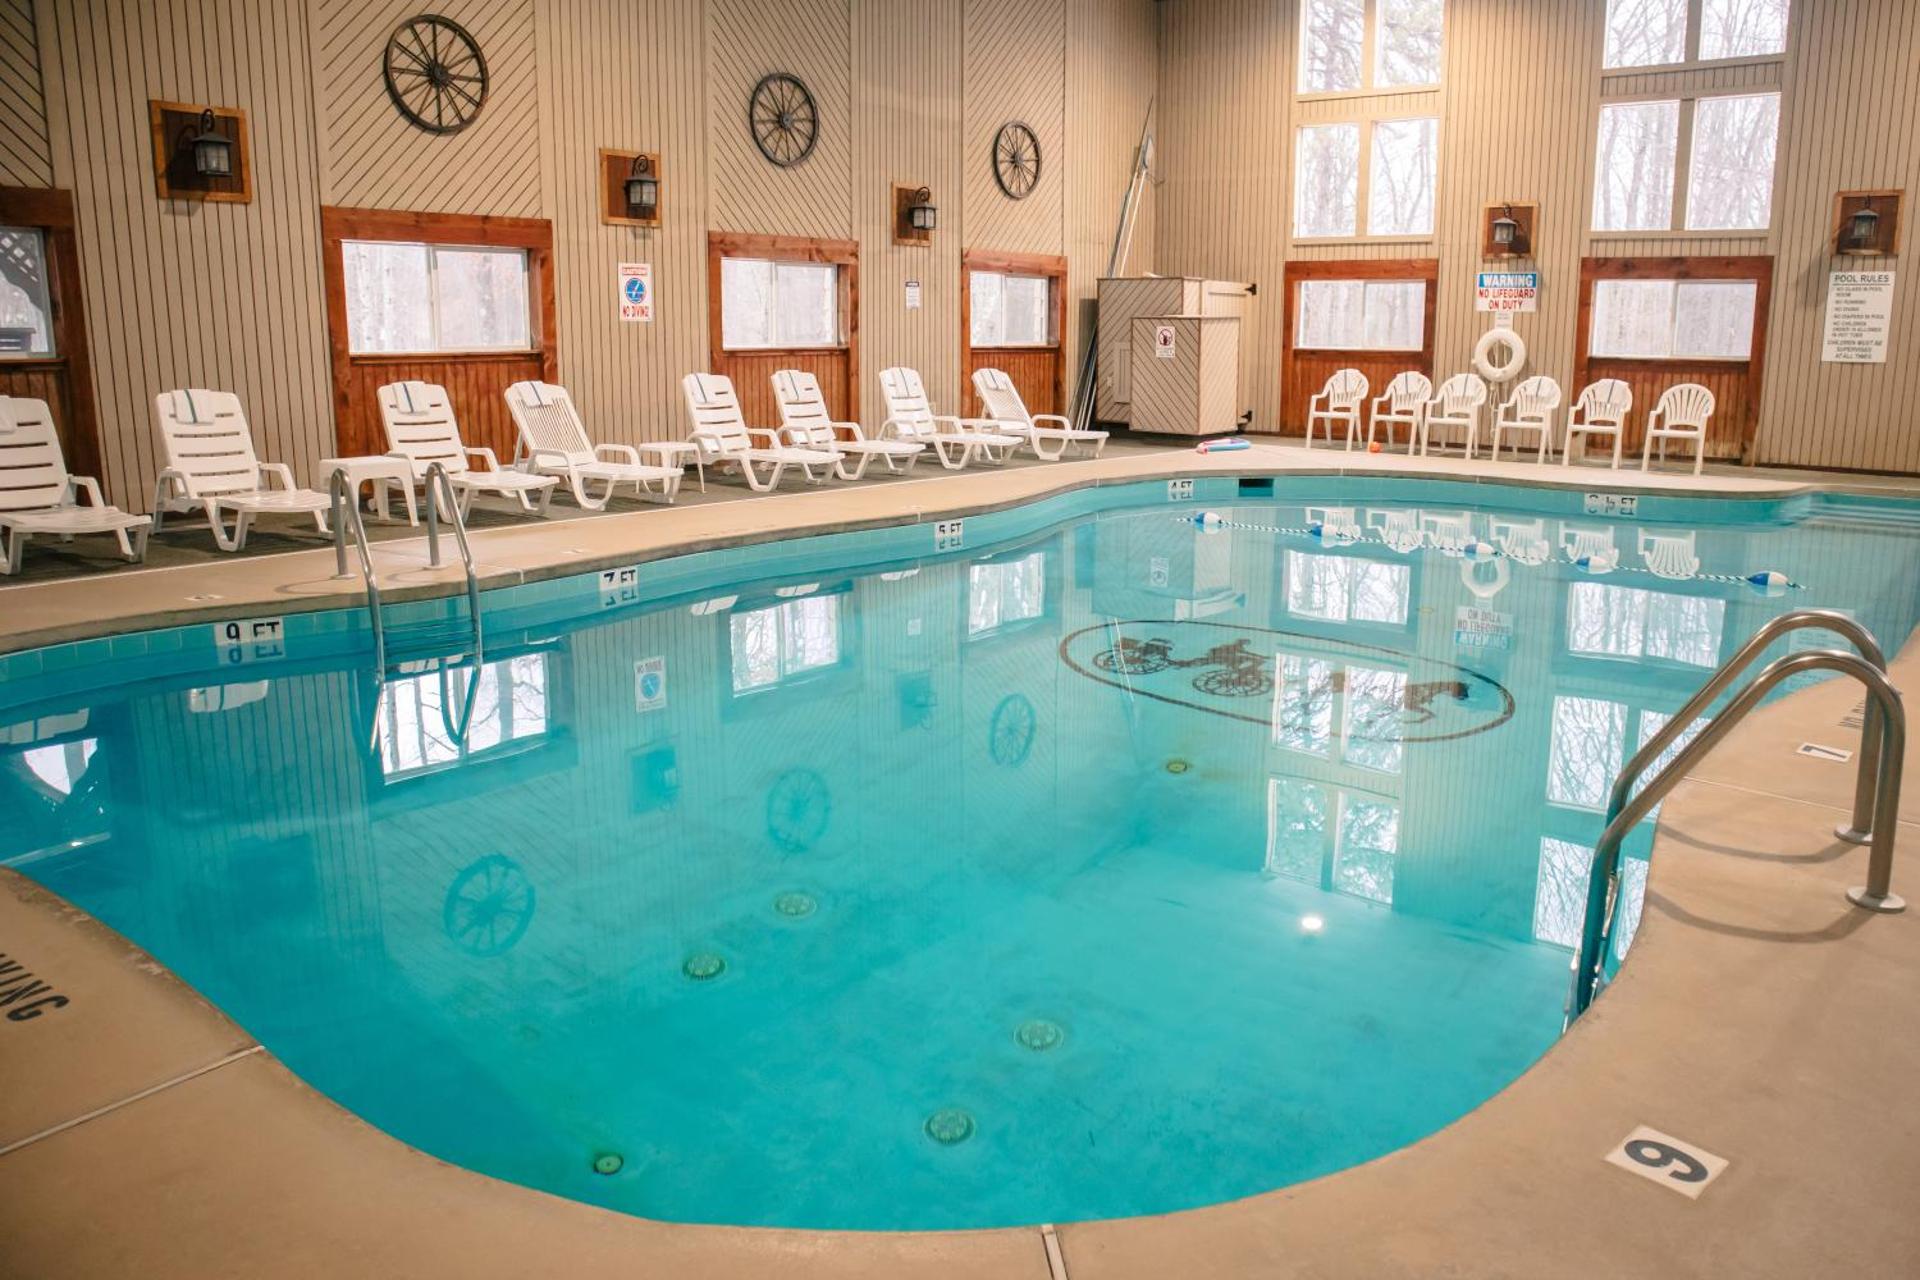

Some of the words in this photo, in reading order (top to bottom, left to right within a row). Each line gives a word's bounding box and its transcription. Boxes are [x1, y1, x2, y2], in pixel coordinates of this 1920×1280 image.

[1483, 274, 1534, 288] WARNING
[1834, 274, 1857, 283] POOL
[1861, 274, 1889, 283] RULES
[1479, 289, 1489, 298] NO
[1492, 289, 1535, 298] LIFEGUARD
[622, 305, 630, 317] NO
[1488, 300, 1499, 310] ON
[1503, 300, 1523, 310] DUTY
[951, 522, 962, 534] FT
[603, 571, 616, 583] 7
[620, 569, 636, 584] FT
[226, 622, 240, 641] 9
[253, 621, 280, 637] FT
